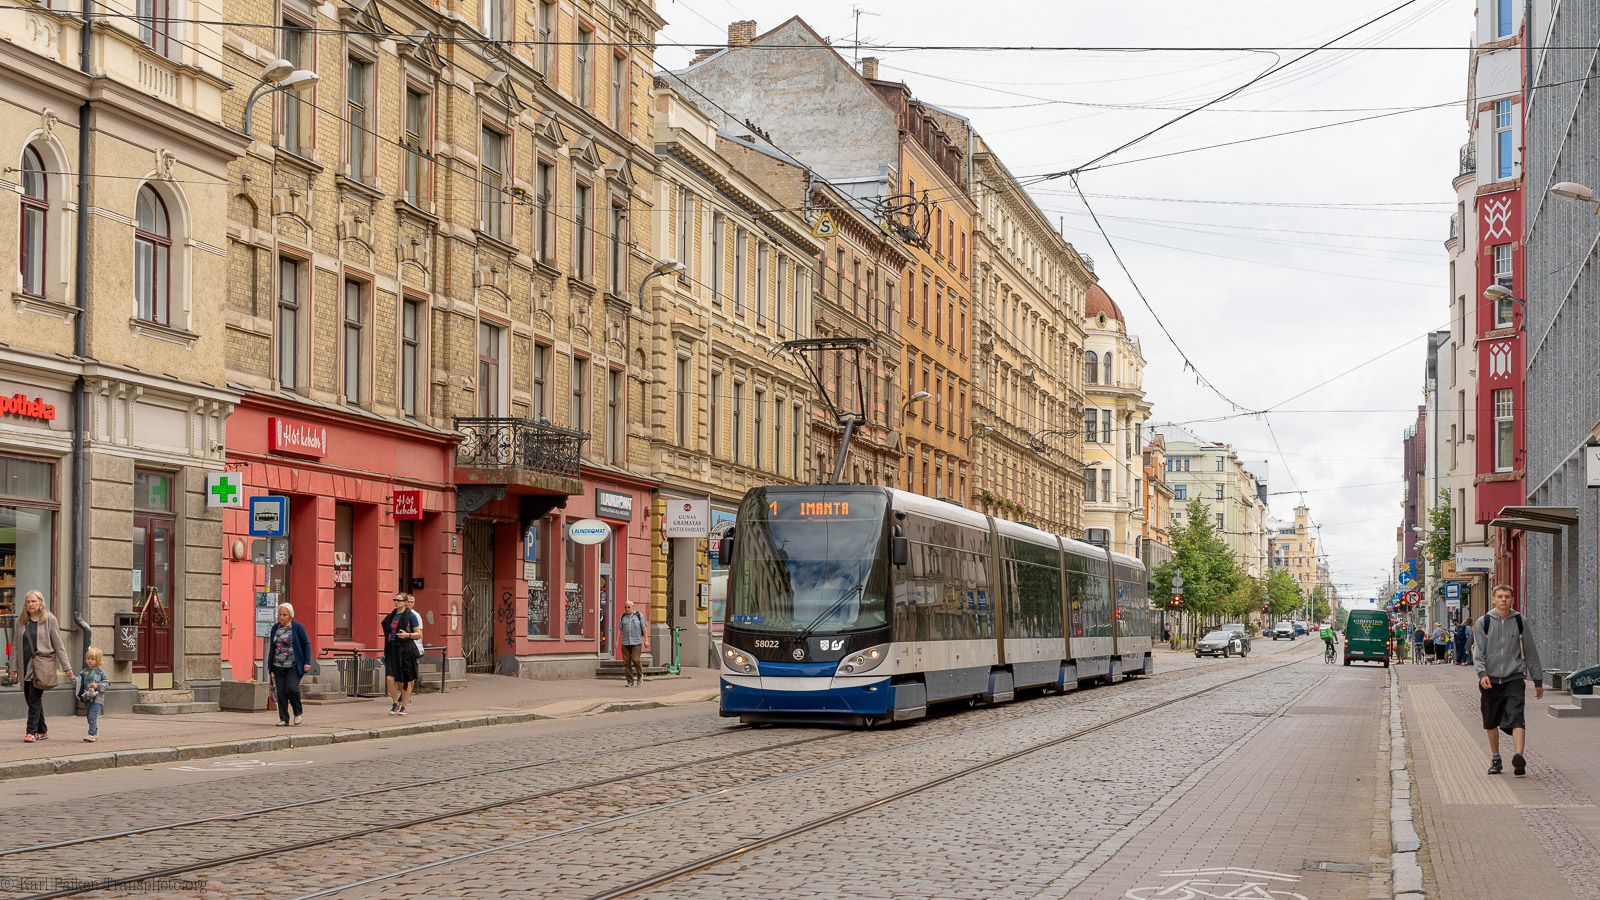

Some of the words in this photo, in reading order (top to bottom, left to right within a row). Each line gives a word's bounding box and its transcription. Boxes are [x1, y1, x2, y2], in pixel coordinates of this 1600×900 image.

[820, 220, 830, 232] S
[301, 425, 321, 448] kebabs
[396, 495, 415, 506] Hot
[395, 505, 418, 515] kebabs
[769, 501, 777, 515] 1
[800, 502, 849, 515] IMANTA
[526, 531, 534, 557] P
[754, 640, 780, 648] 58022
